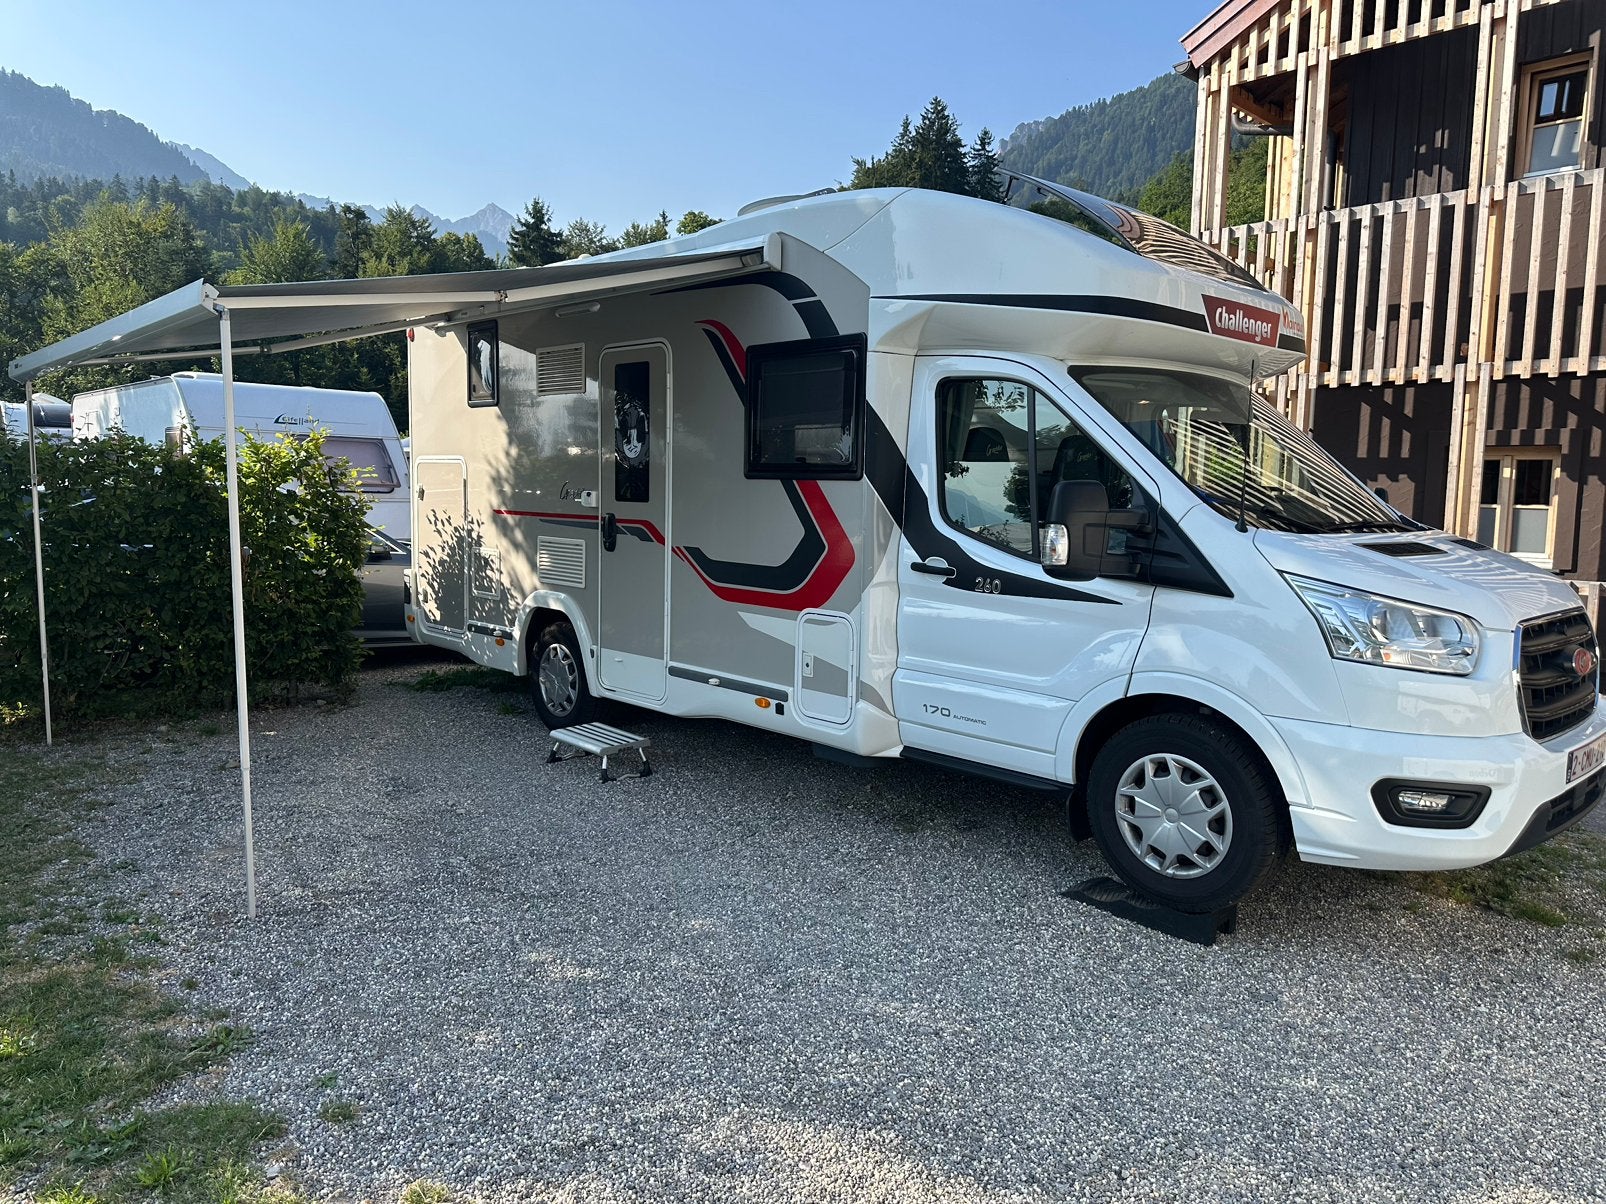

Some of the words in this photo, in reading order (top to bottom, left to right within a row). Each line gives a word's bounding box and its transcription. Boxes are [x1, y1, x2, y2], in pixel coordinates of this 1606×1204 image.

[1215, 306, 1272, 342] Challenger
[974, 576, 1002, 594] 260
[922, 703, 951, 718] 170
[953, 714, 987, 726] AUTOMATIC
